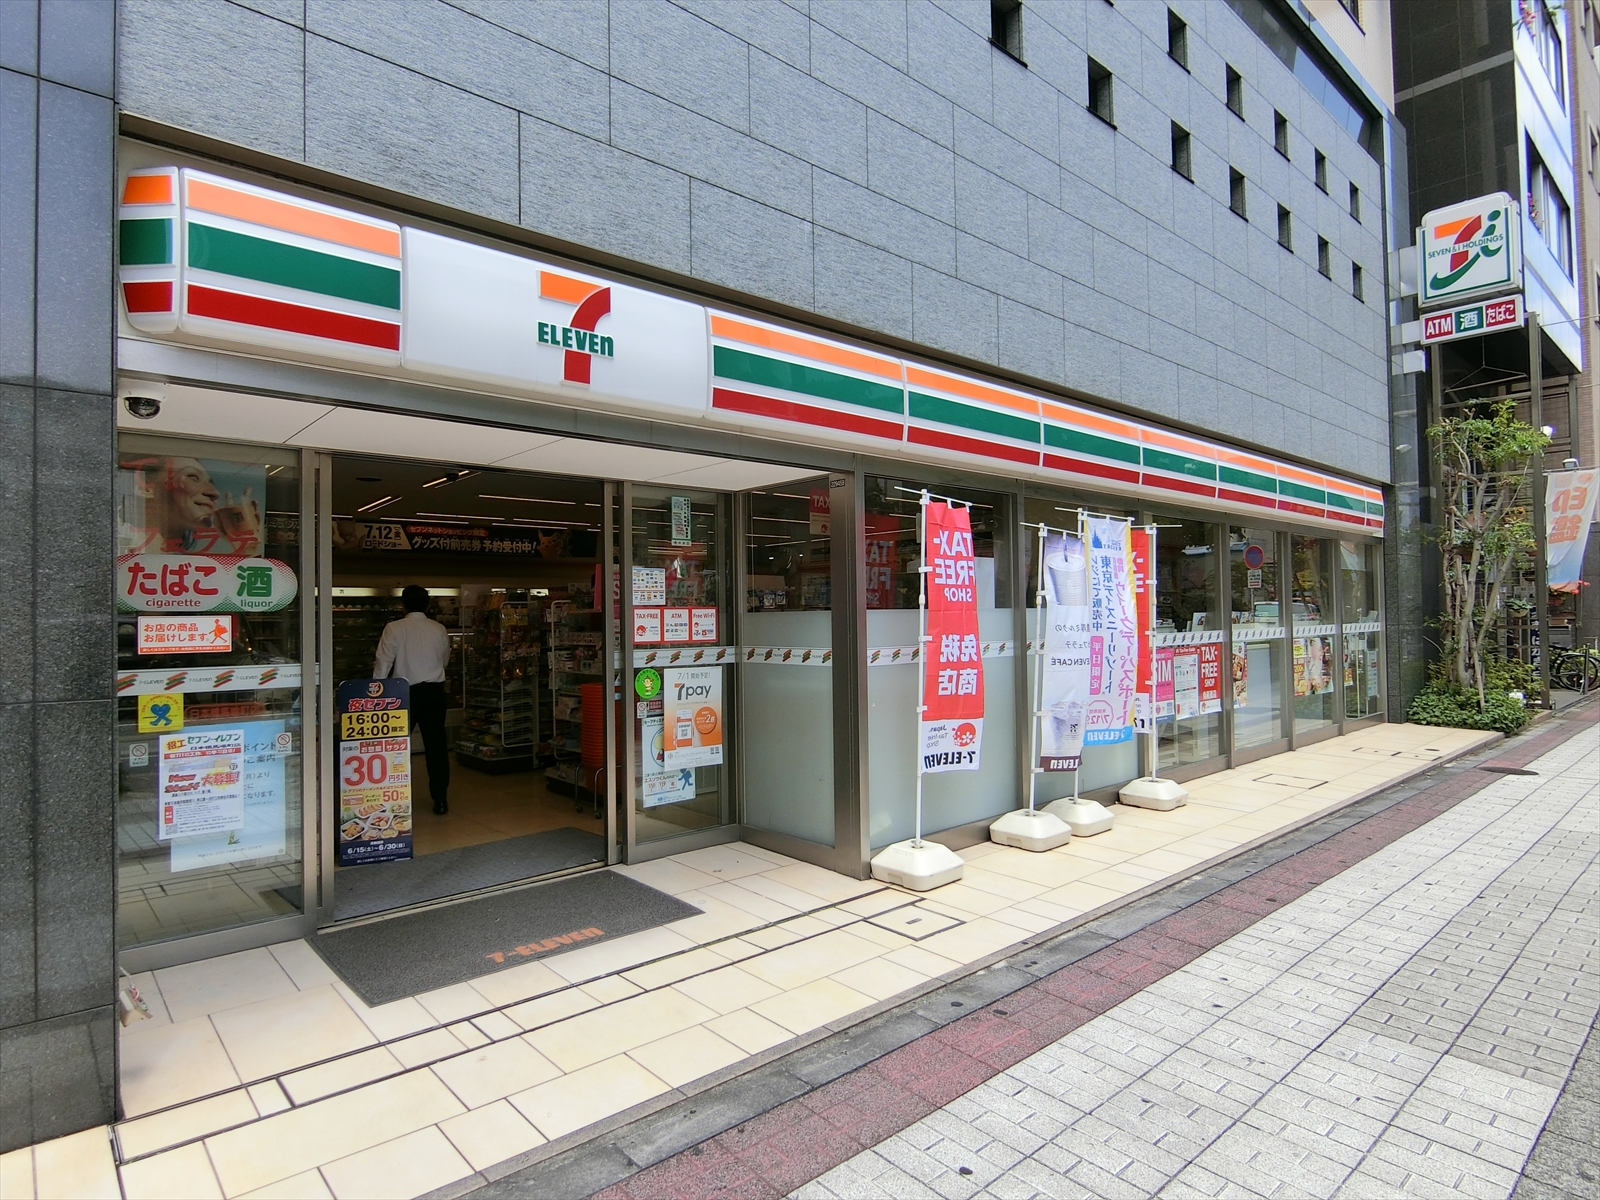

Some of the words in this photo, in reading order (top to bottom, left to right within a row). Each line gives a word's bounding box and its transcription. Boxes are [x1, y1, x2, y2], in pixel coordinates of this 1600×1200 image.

[1463, 234, 1504, 250] HOLDINGS
[1460, 311, 1479, 330] 酒
[1486, 304, 1515, 324] たばこ
[1426, 316, 1452, 336] ATM
[364, 525, 392, 540] 7.12
[364, 540, 402, 548] ロードショー
[412, 535, 481, 551] グッズ付前売券
[127, 561, 219, 596] たばこ
[236, 565, 273, 598] 酒
[145, 598, 201, 608] cigarette
[240, 598, 274, 609] liquor
[144, 622, 199, 633] お店の商品
[143, 633, 209, 643] お届けします。
[1201, 645, 1218, 662] TAX-
[677, 672, 690, 680] 7/1
[1201, 662, 1218, 678] FREE
[1204, 678, 1215, 688] SHOP
[348, 698, 402, 712] 夜セブン
[344, 753, 388, 787] 30
[383, 790, 399, 803] 50
